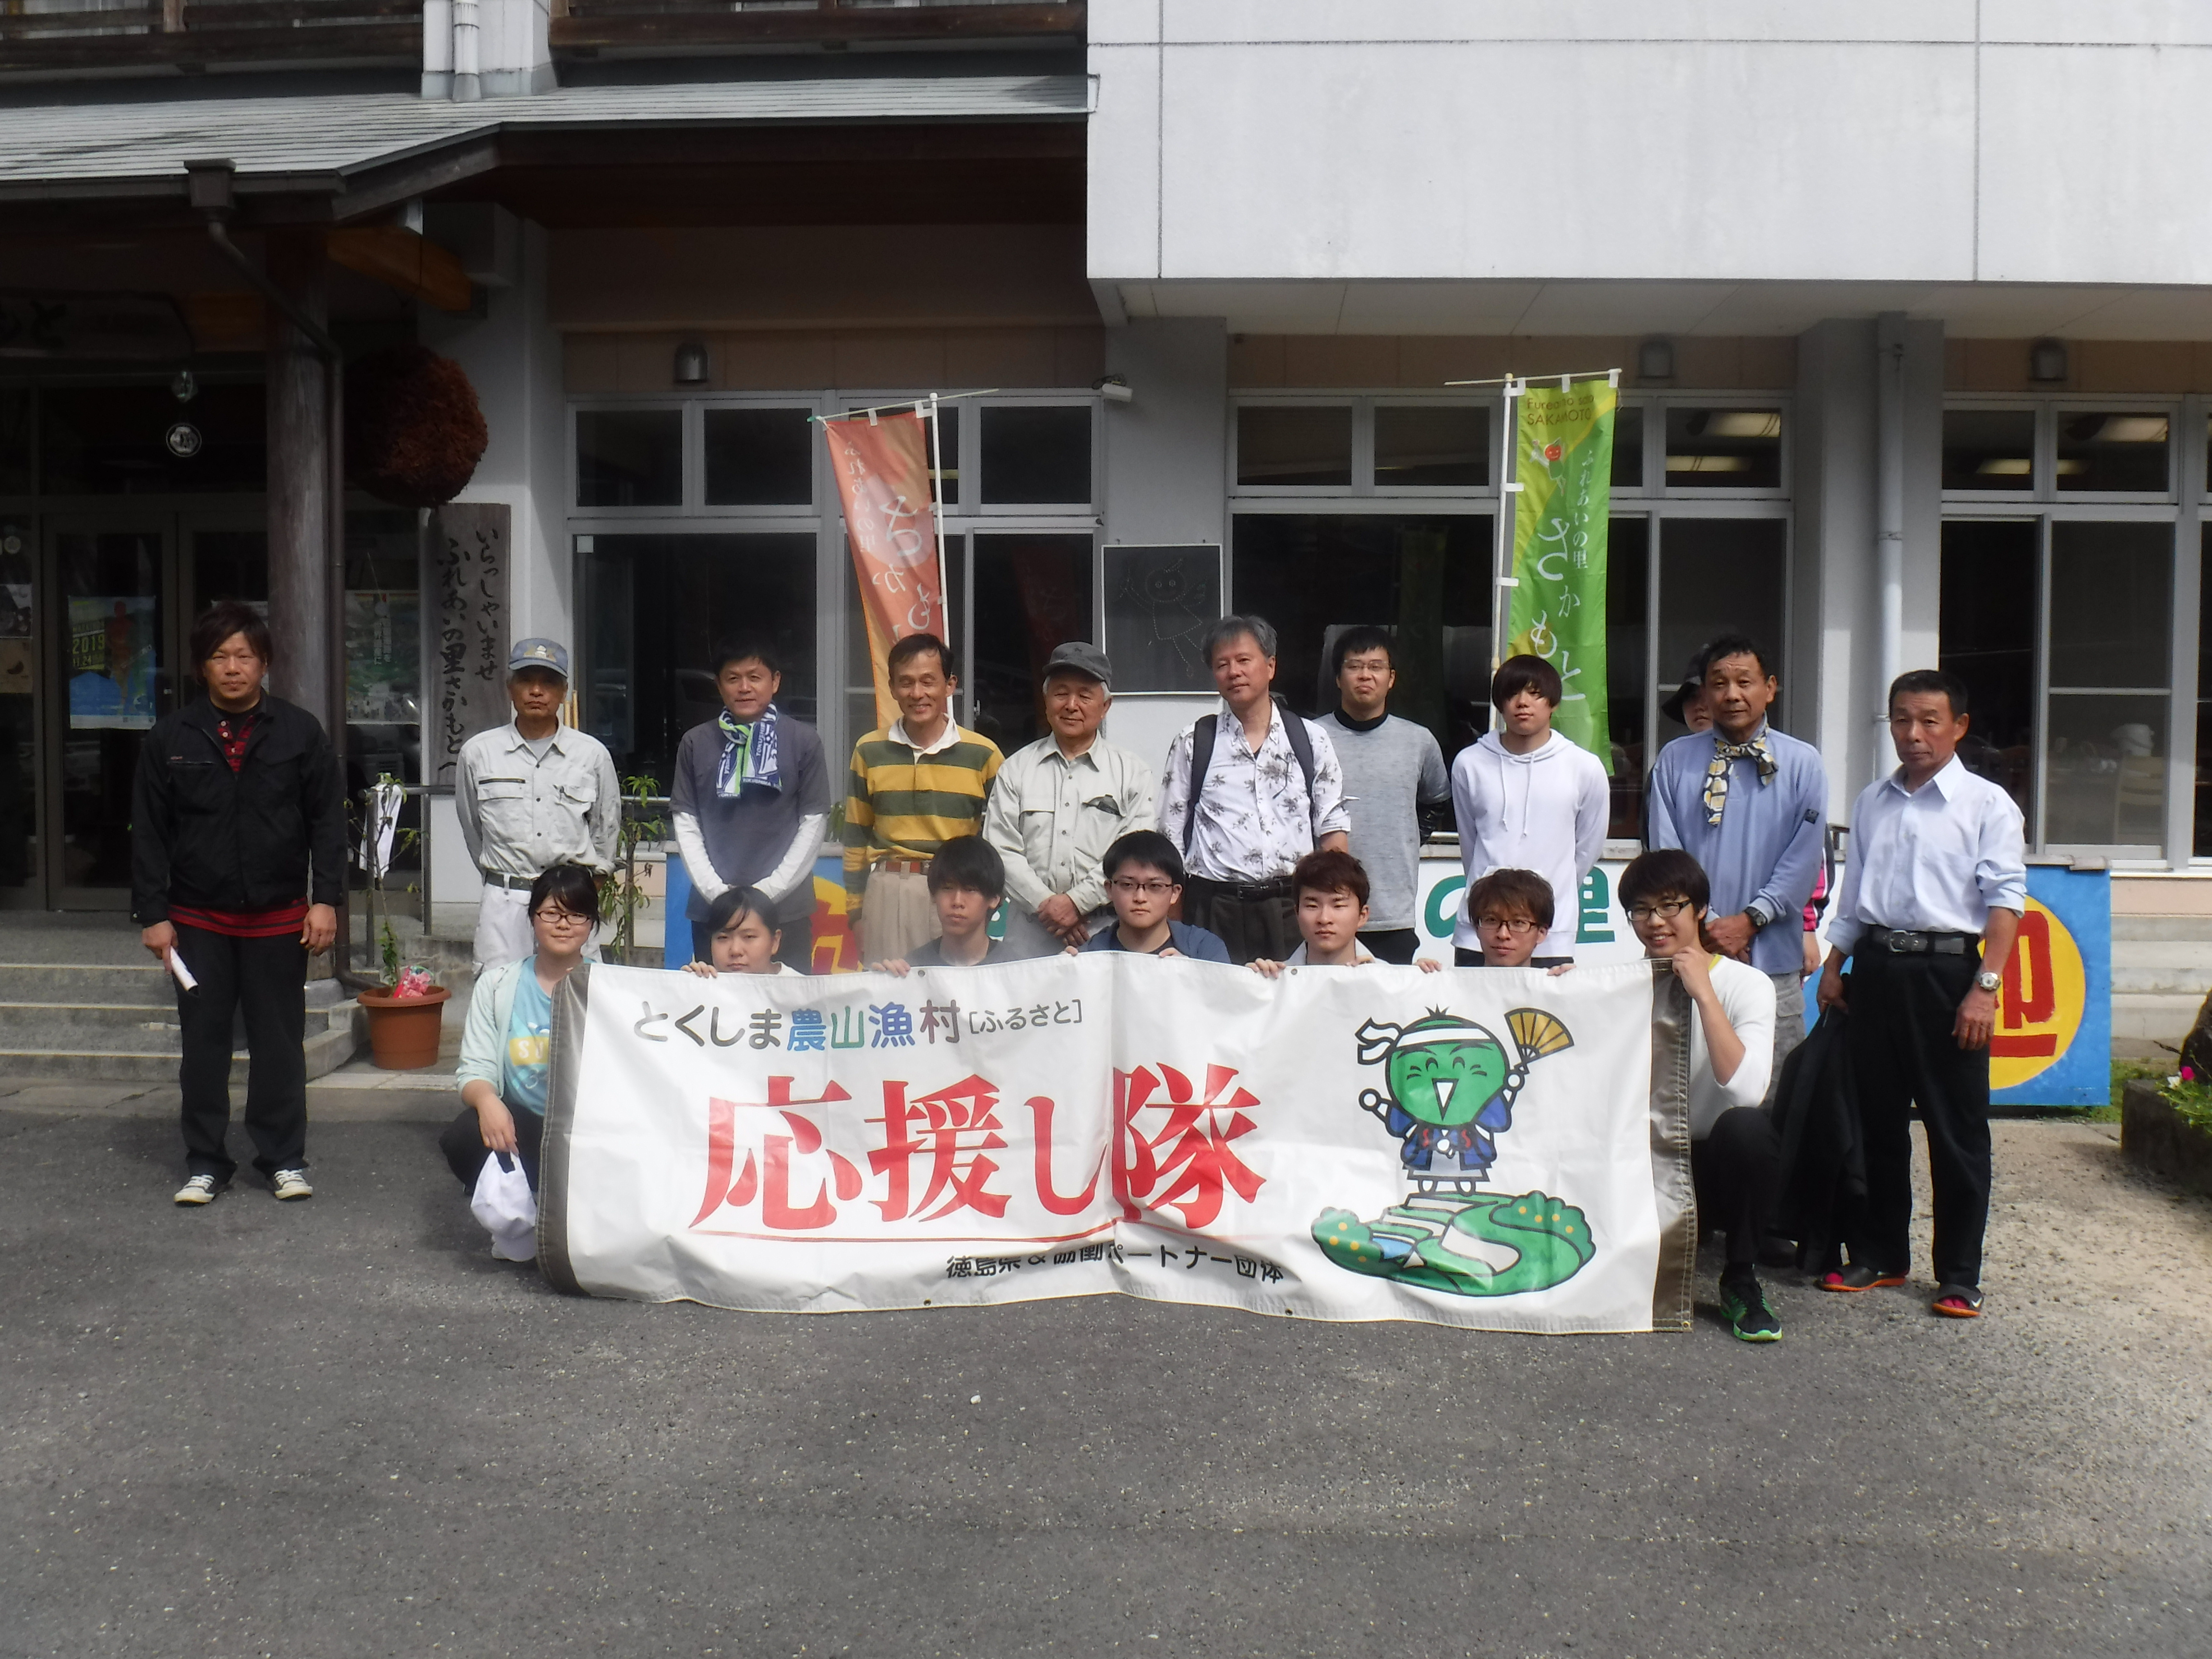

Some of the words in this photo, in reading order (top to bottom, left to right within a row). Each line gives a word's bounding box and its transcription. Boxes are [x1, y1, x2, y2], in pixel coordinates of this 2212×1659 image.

[1572, 450, 1594, 569] ふれあいの里
[72, 634, 105, 655] 2019
[475, 529, 499, 681] いらっしゃいませ
[688, 1061, 1267, 1230] 応援し隊
